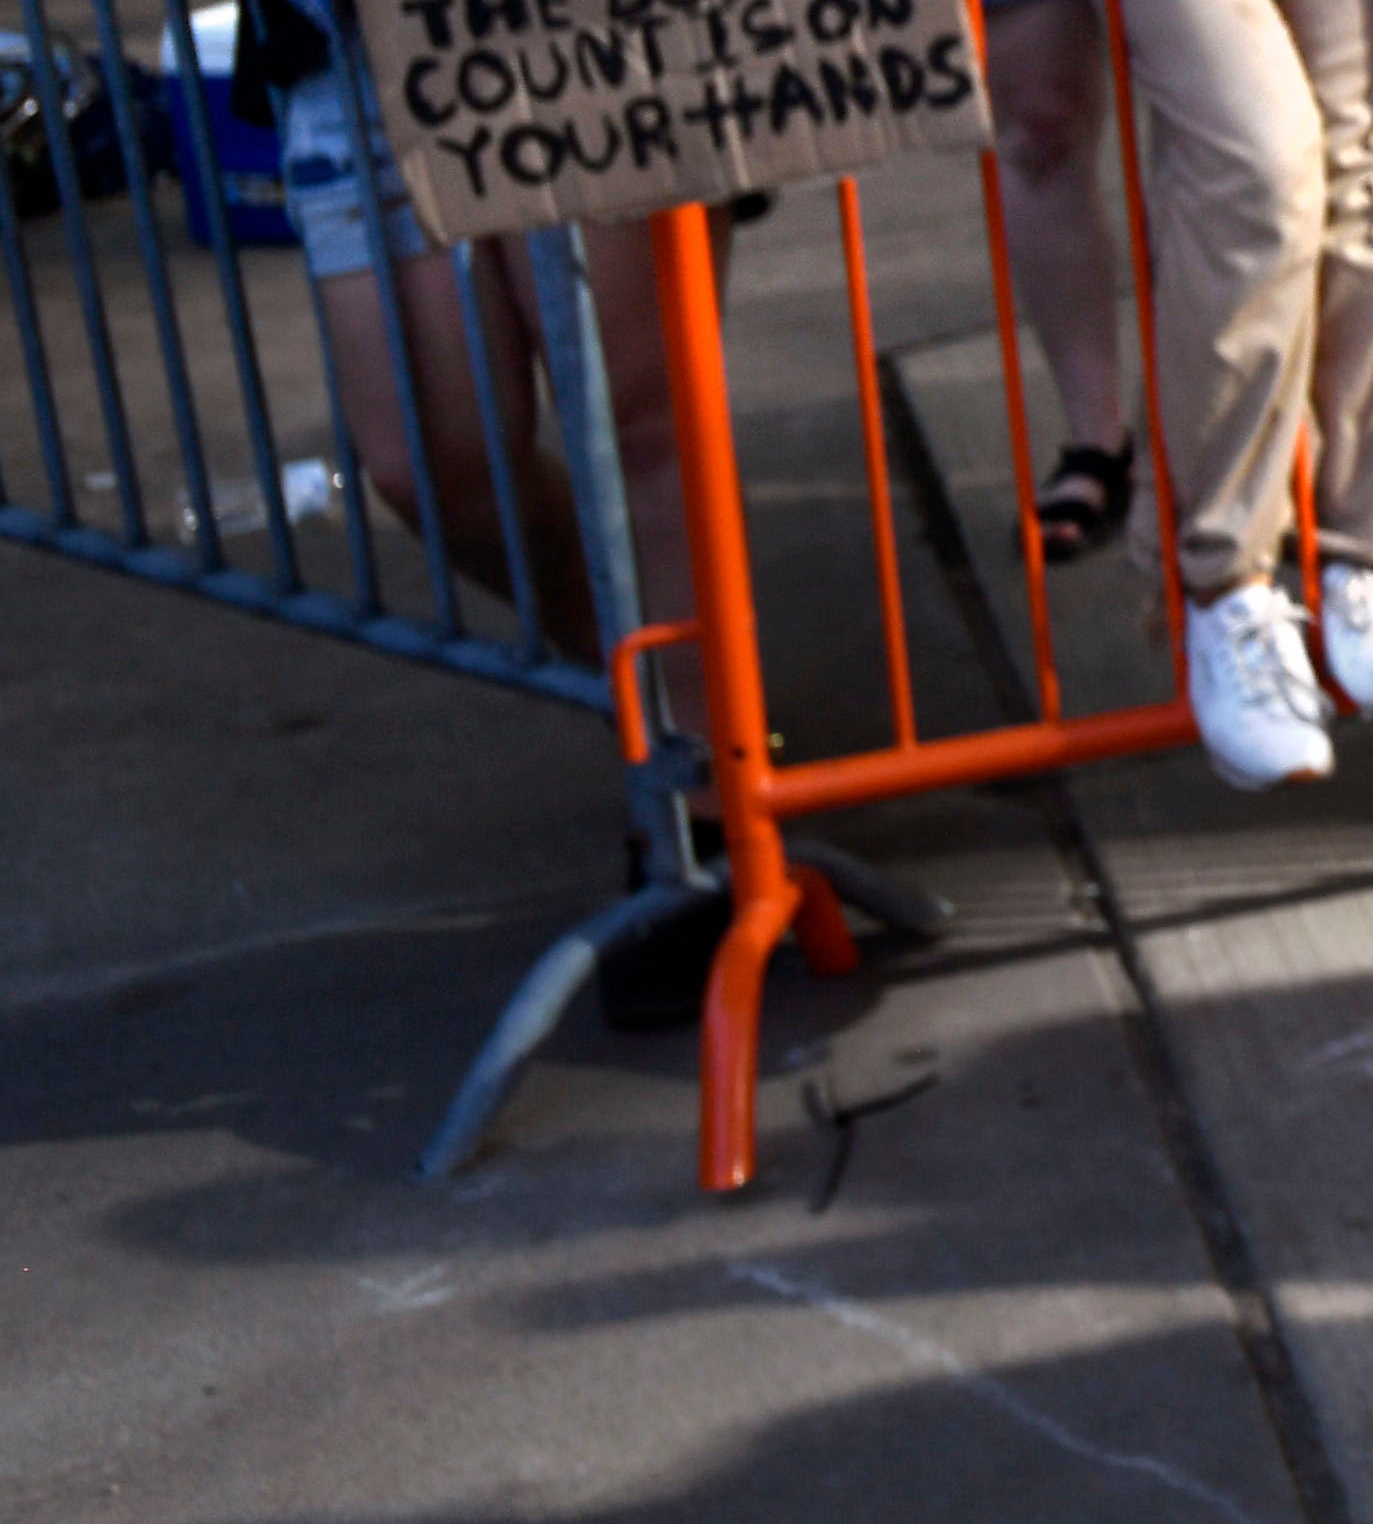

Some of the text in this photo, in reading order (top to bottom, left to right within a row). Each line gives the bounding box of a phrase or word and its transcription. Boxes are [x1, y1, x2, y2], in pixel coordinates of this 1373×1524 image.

[405, 15, 668, 127] COUNT
[436, 33, 976, 198] YOUR HANDS
